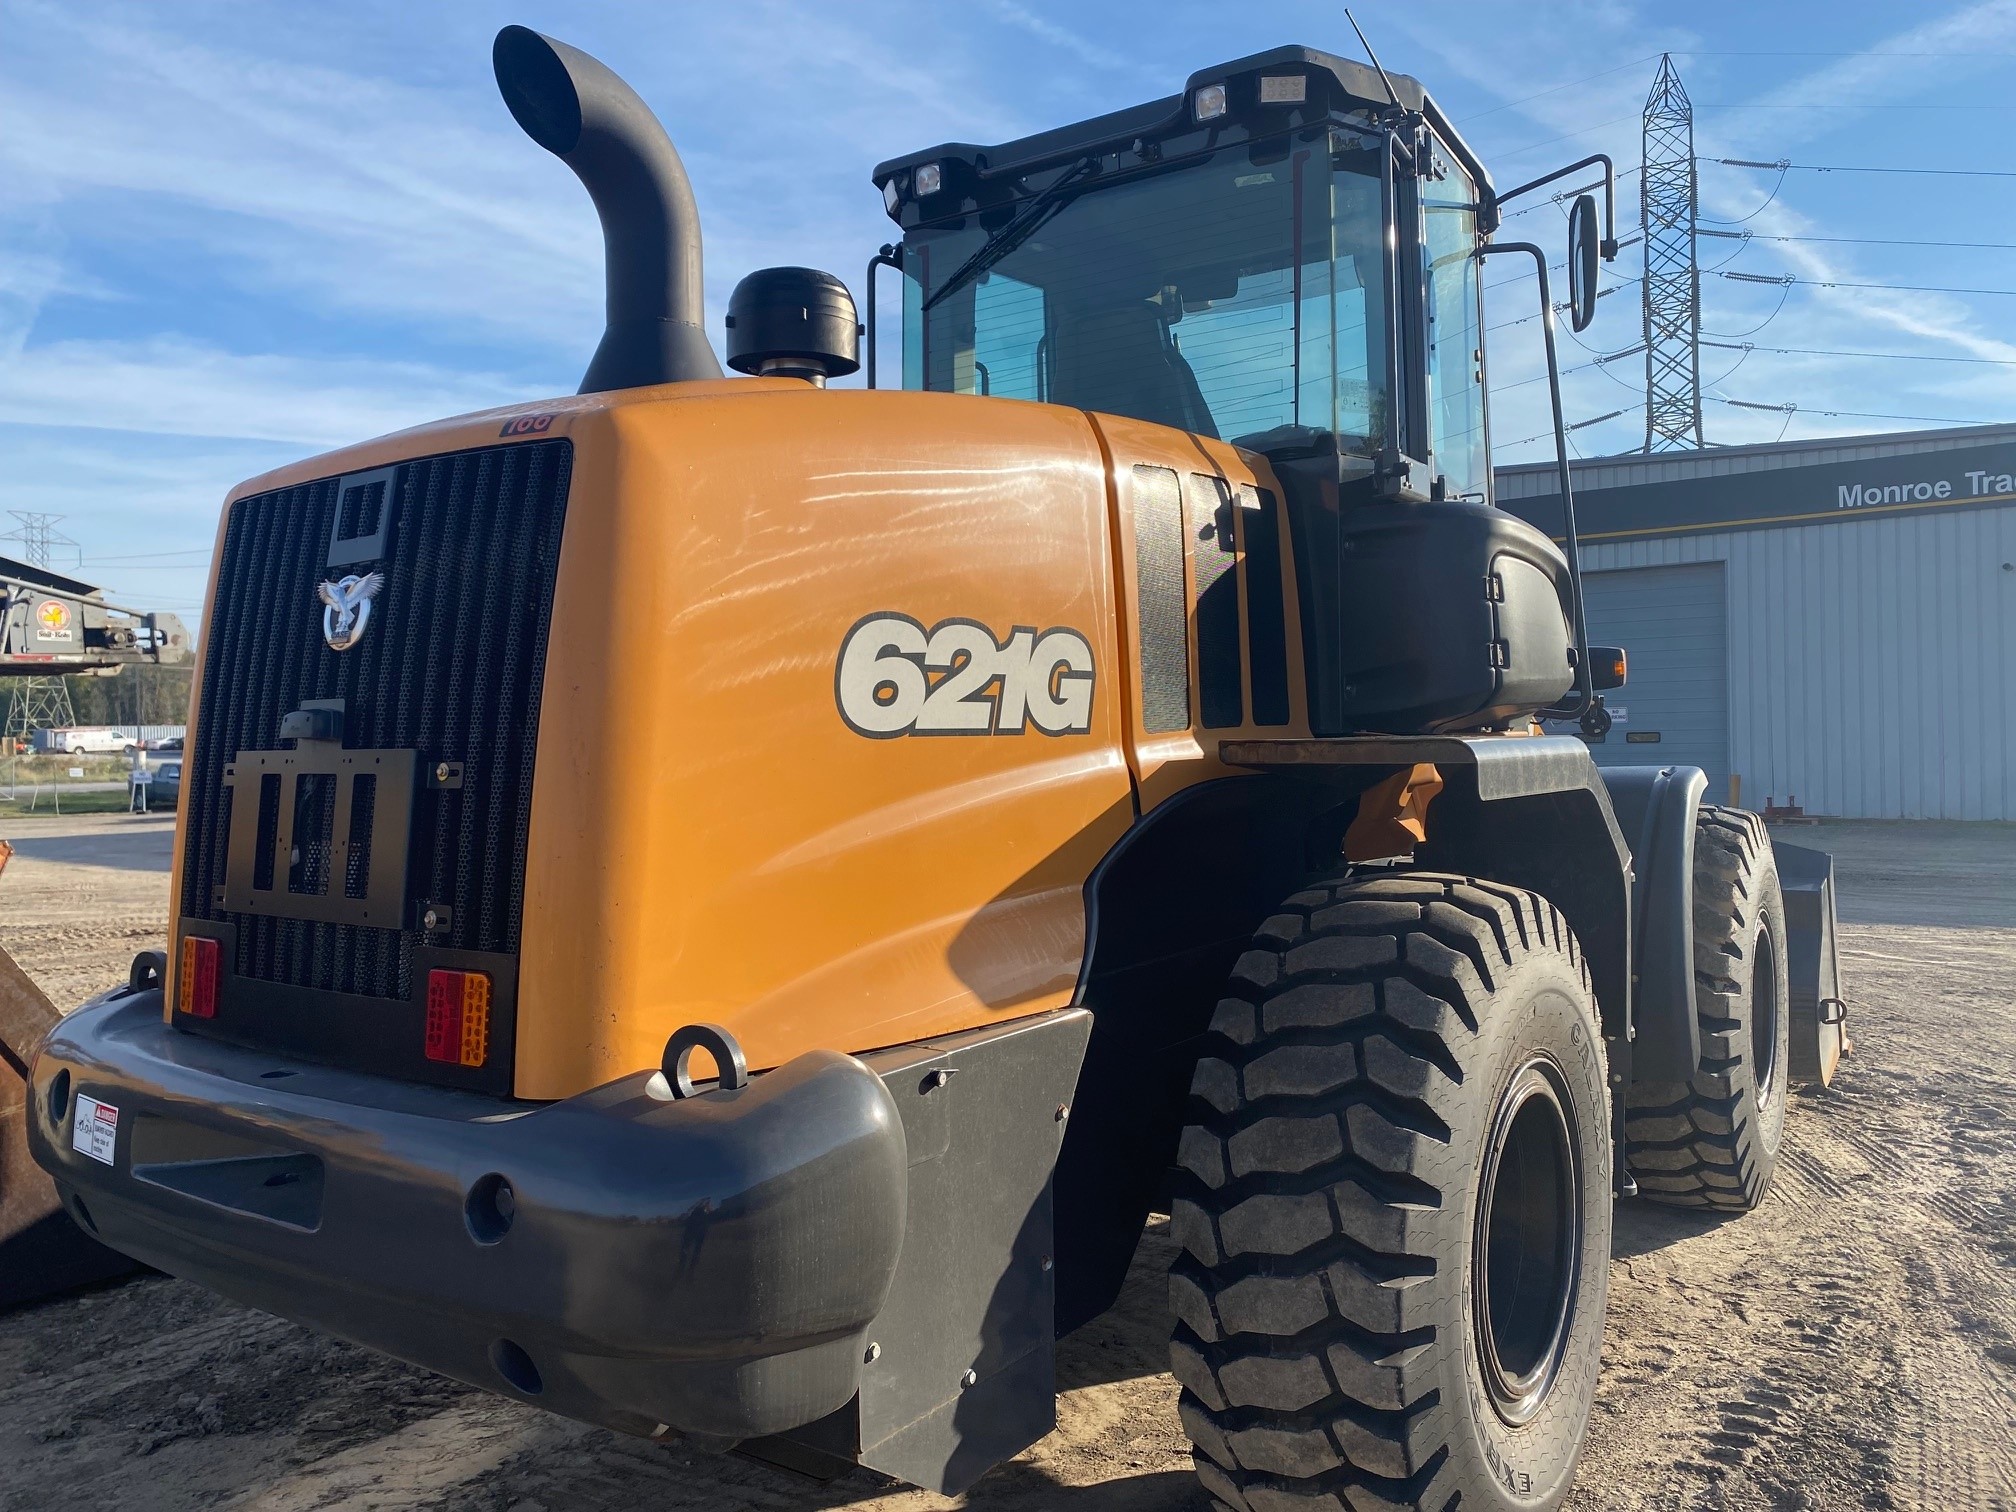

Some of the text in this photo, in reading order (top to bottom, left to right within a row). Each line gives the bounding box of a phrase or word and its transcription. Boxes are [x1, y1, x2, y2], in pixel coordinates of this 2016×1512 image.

[1838, 470, 2016, 508] Monroe Tra
[835, 612, 1096, 738] 621G
[1570, 1022, 1607, 1181] GALAXY
